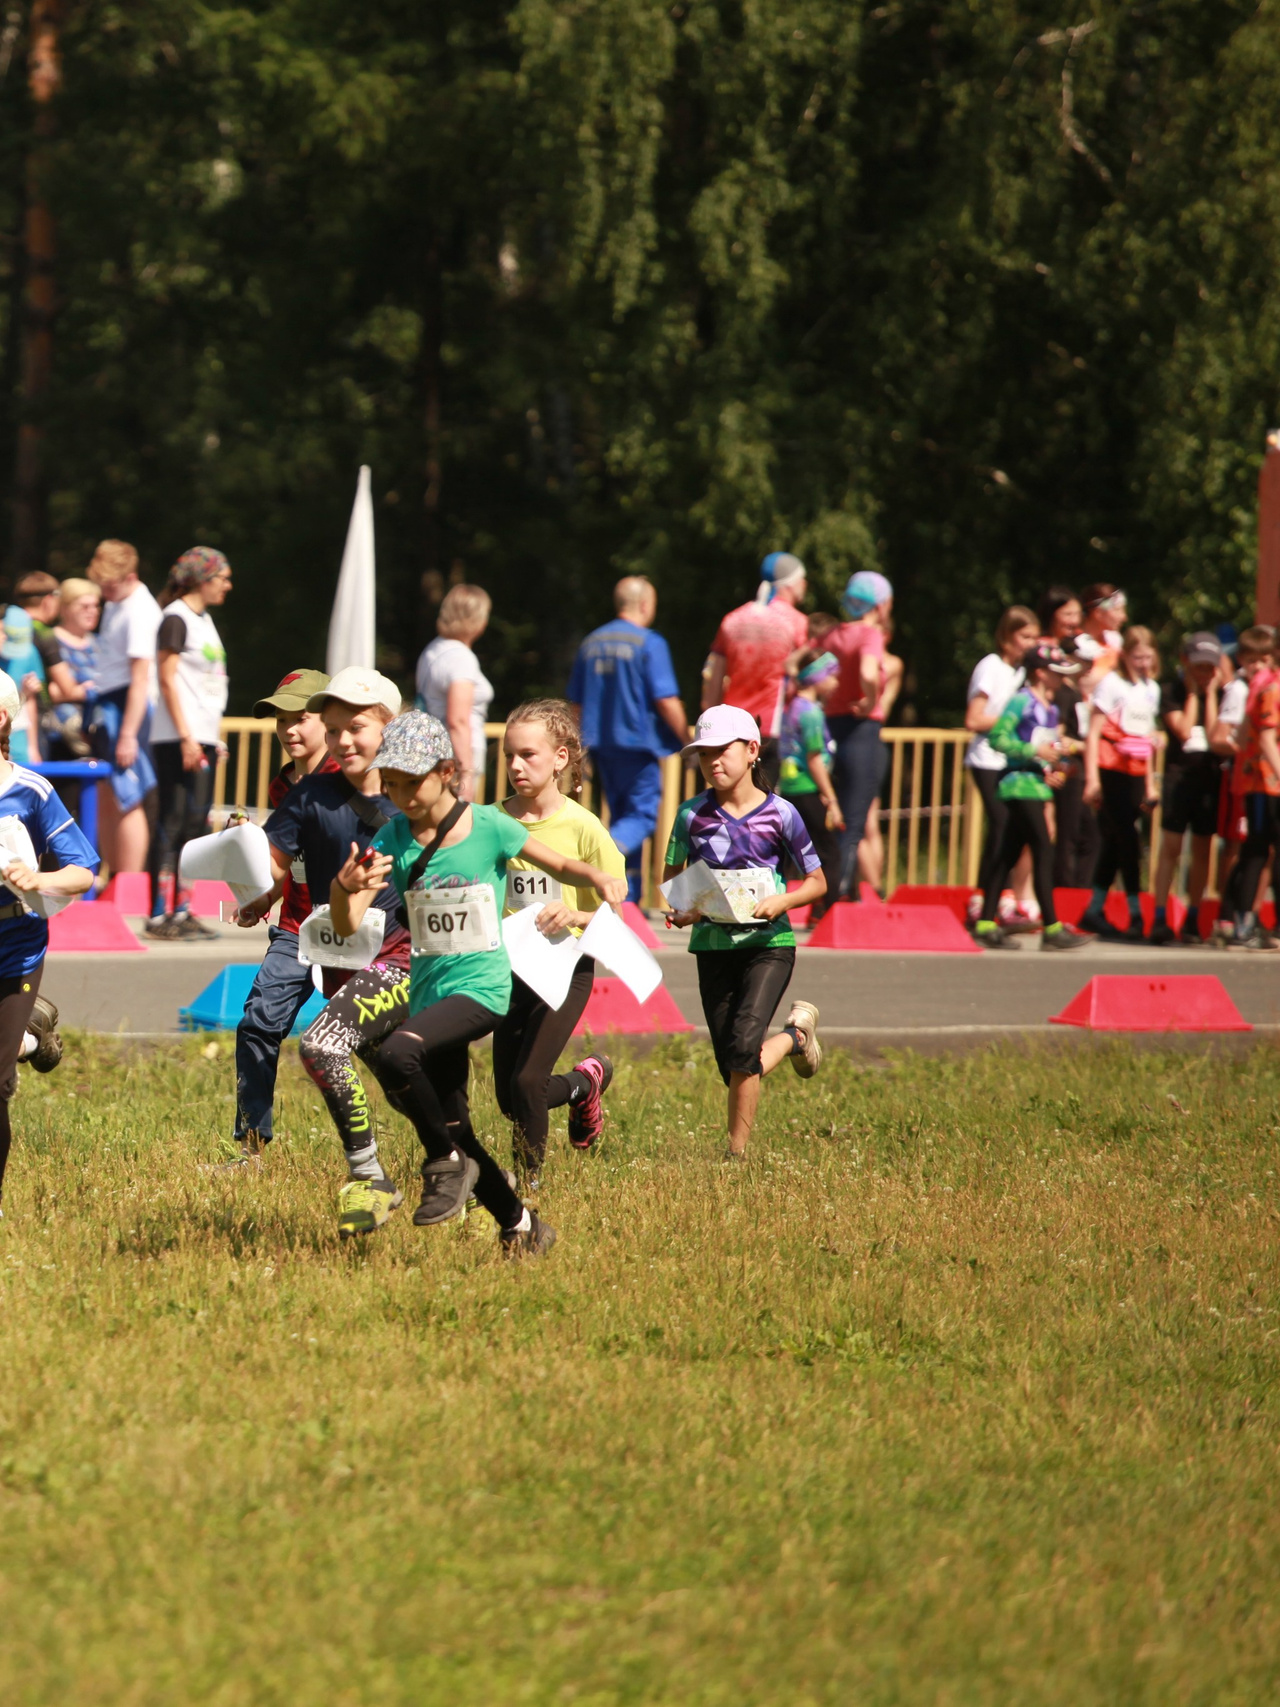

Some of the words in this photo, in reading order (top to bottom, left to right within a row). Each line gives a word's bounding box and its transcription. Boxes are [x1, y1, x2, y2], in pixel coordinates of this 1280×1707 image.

[513, 876, 548, 895] 611
[427, 911, 468, 933] 607
[320, 926, 355, 948] 60
